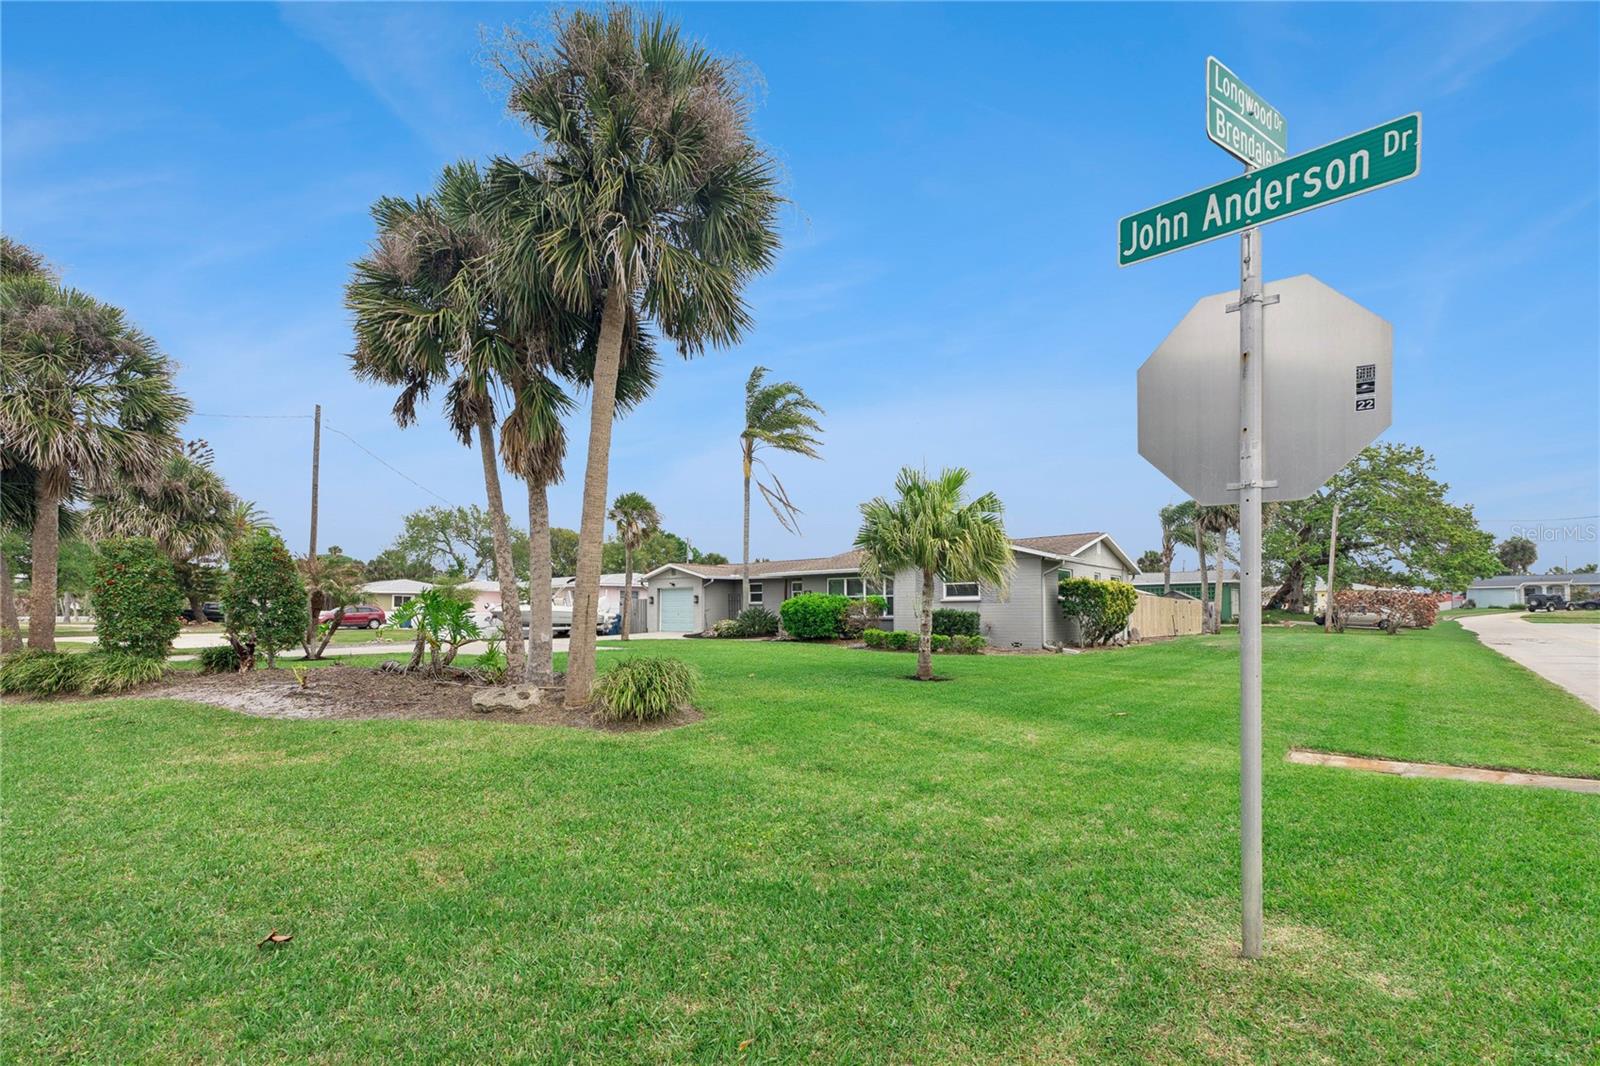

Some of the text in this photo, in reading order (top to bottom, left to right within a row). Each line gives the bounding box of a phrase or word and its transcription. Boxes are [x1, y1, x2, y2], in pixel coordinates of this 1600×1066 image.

[1215, 65, 1283, 131] Longwood Dr
[1216, 108, 1272, 166] Brendale
[1122, 128, 1413, 256] John Anderson Dr
[1357, 399, 1374, 410] 22
